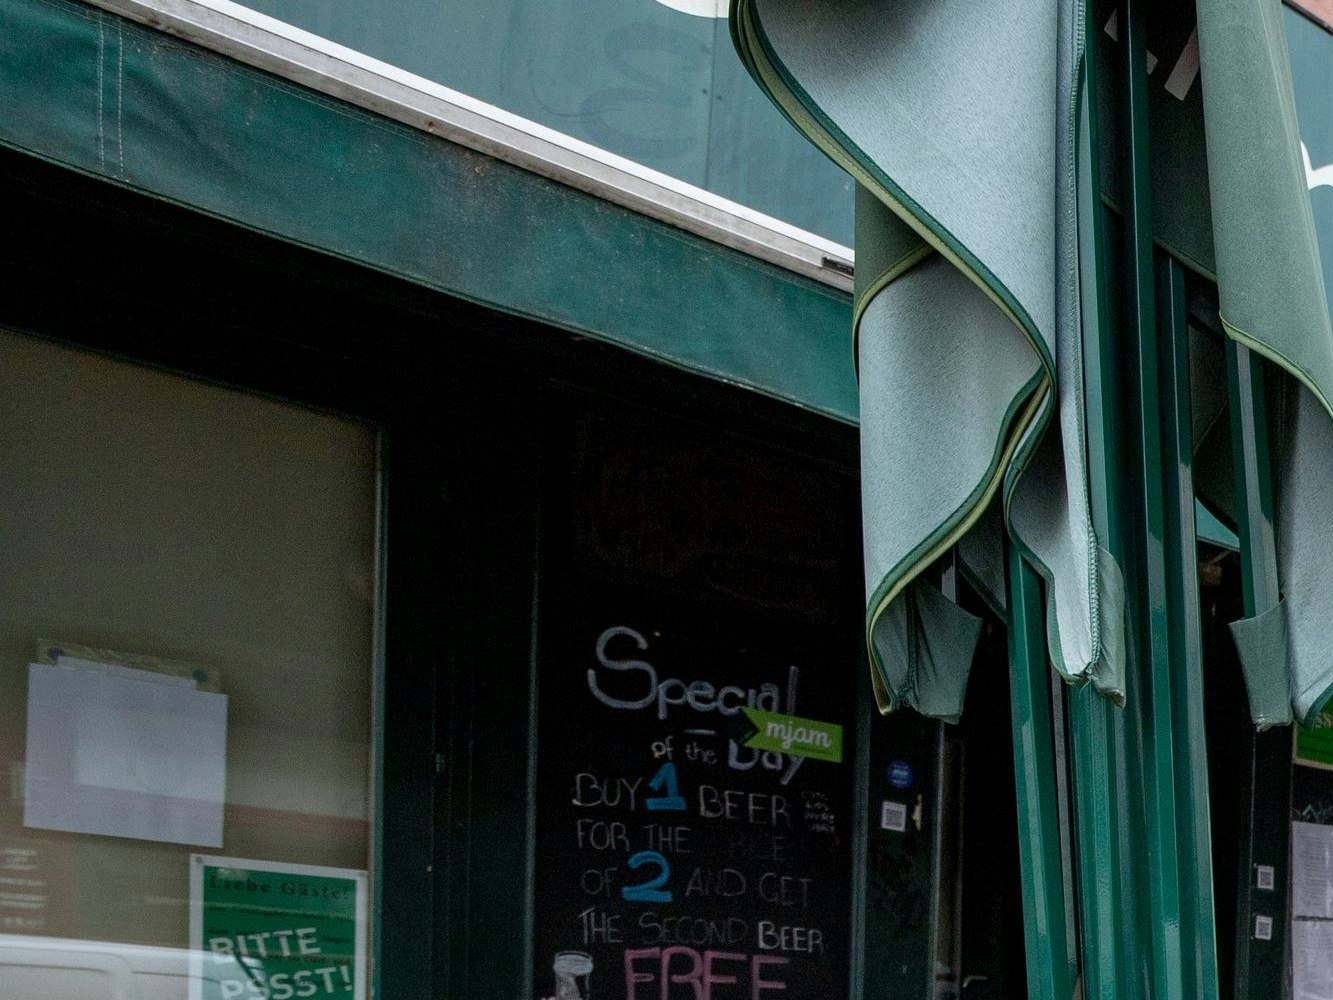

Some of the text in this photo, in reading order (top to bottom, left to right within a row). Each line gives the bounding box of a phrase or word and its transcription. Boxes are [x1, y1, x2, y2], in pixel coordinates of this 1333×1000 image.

[587, 626, 800, 719] Special
[688, 744, 718, 765] the
[765, 718, 833, 751] mjam
[572, 773, 642, 812] BUY
[645, 762, 687, 811] 1
[700, 786, 791, 827] BEER
[577, 819, 630, 851] FOR
[621, 850, 674, 903] 2
[208, 927, 322, 963] BITTE
[577, 907, 625, 945] THE
[759, 921, 824, 953] BEER
